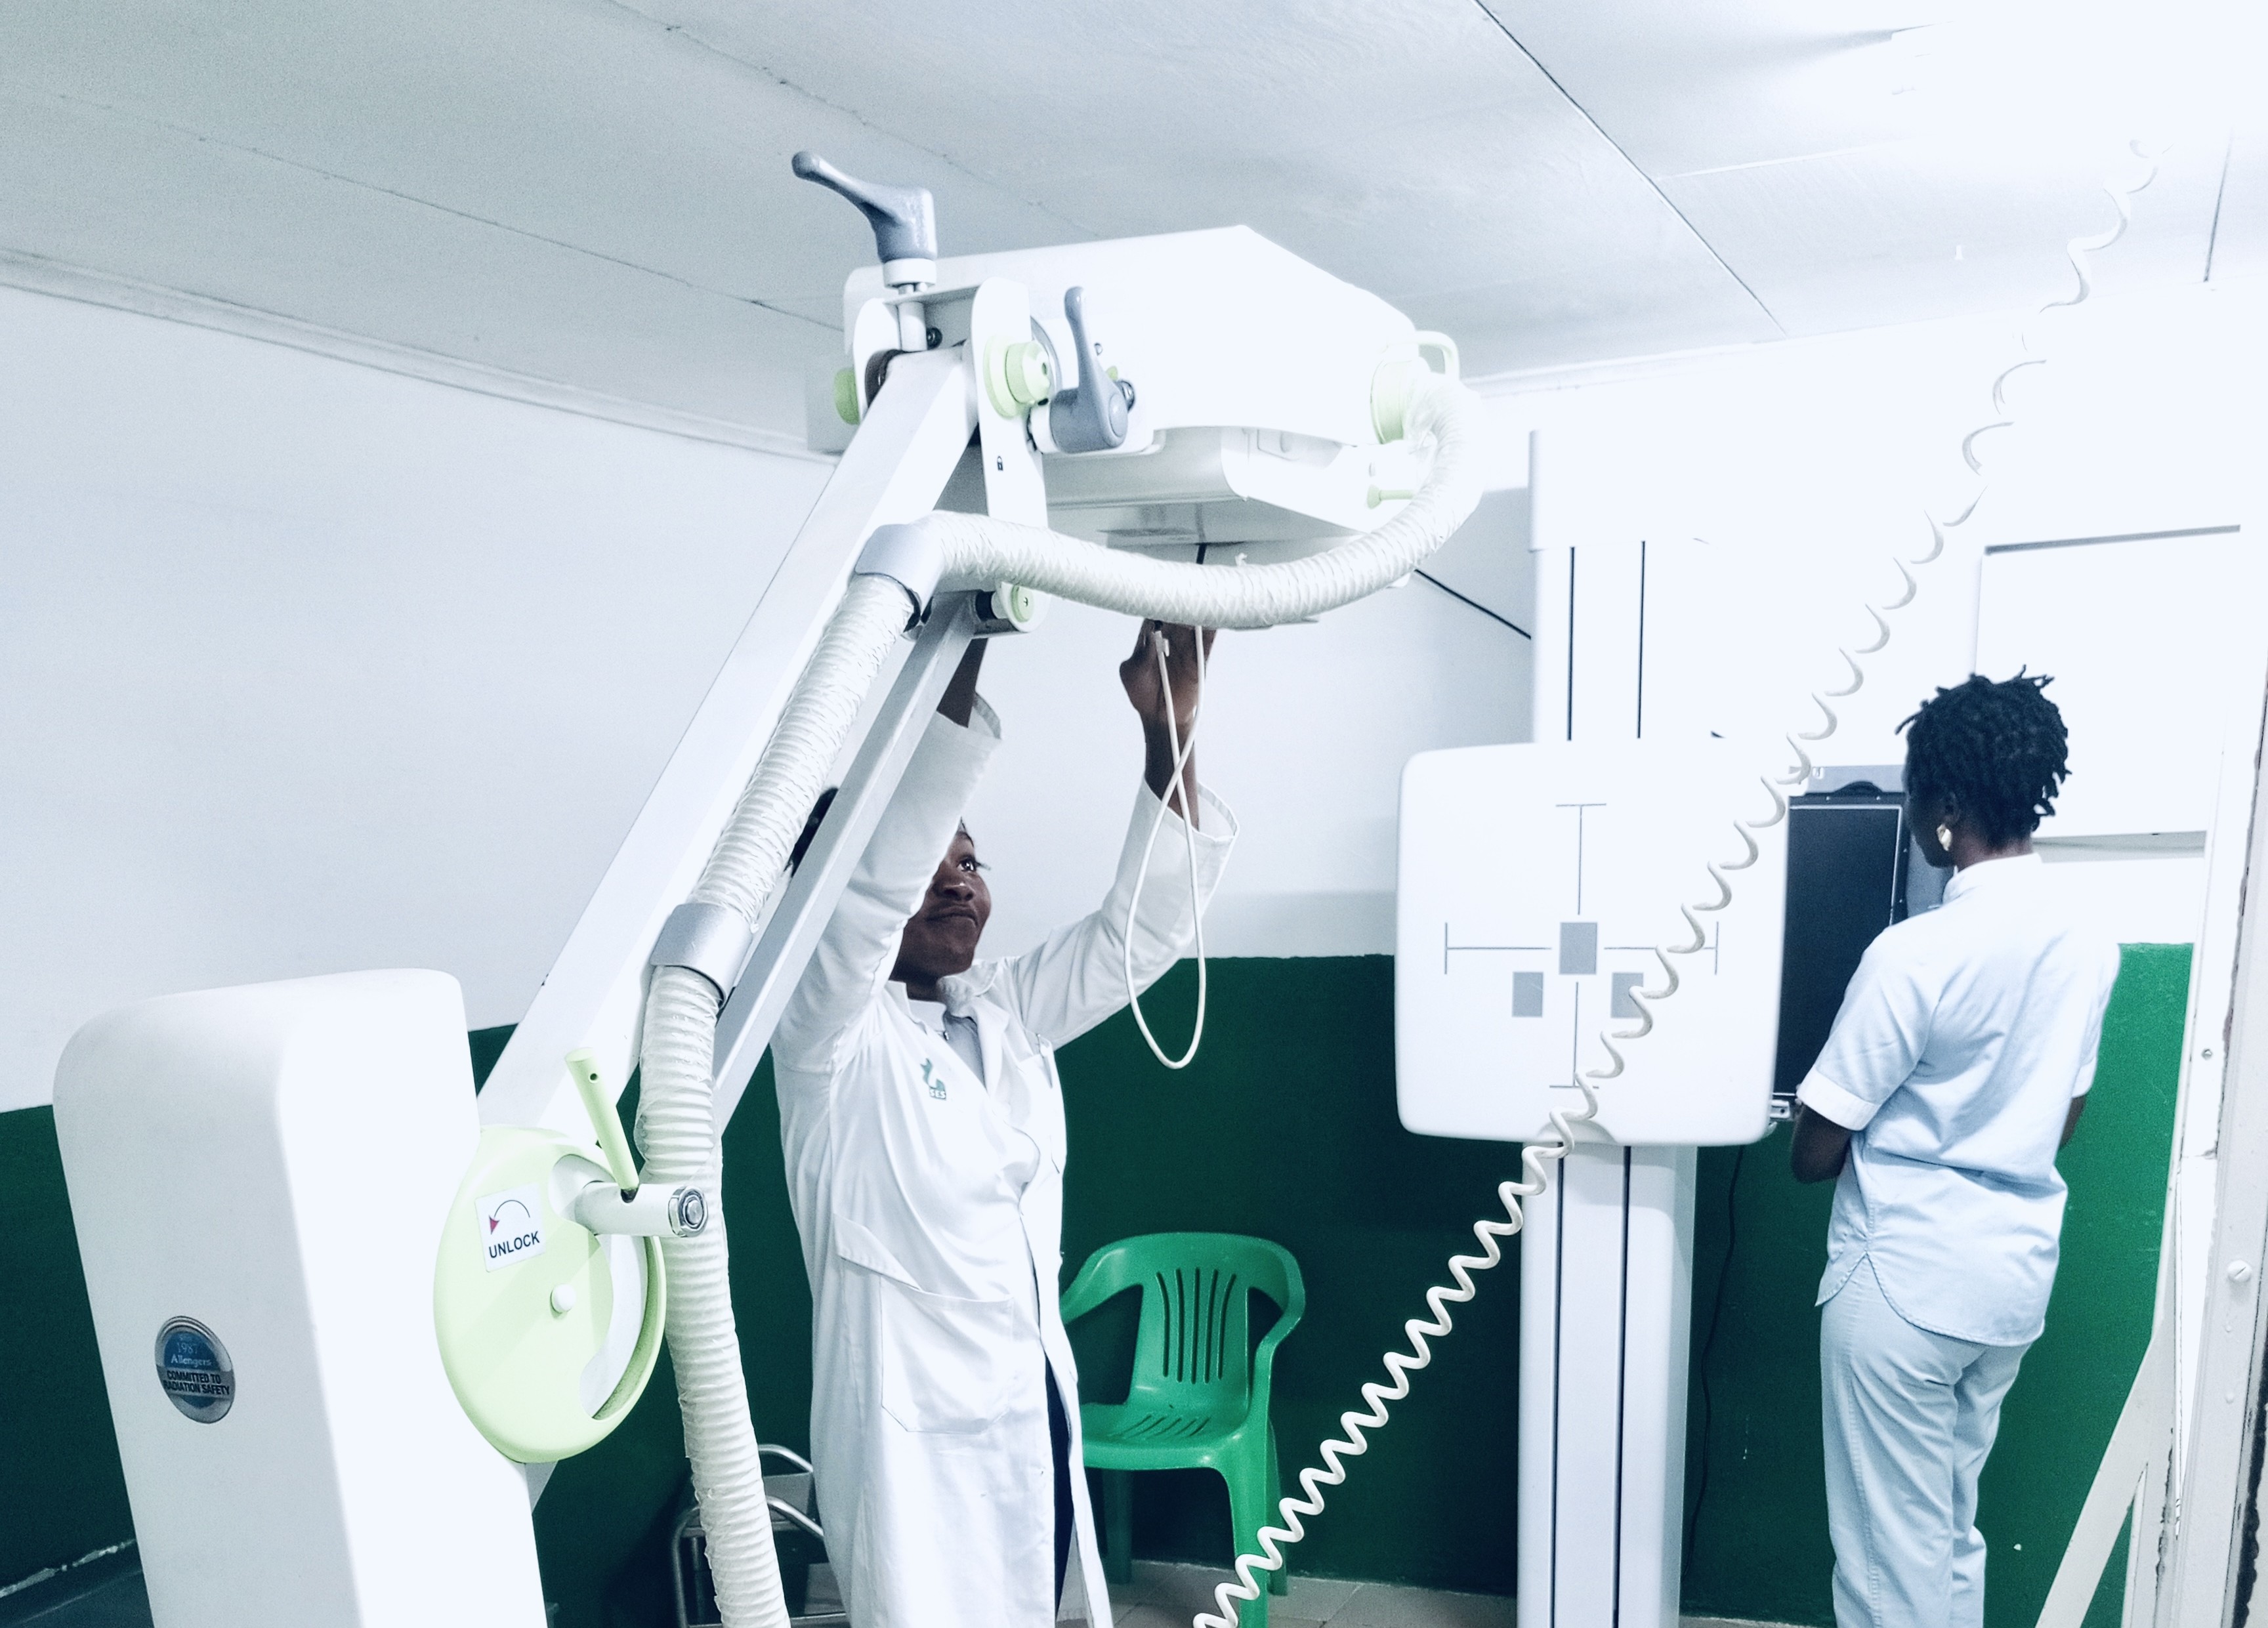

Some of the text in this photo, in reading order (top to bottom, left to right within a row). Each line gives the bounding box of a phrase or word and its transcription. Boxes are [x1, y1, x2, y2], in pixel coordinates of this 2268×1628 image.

[489, 1230, 540, 1259] UNLOCK
[171, 1354, 212, 1367] Allengers
[167, 1370, 221, 1384] COMMITTED TO
[202, 1383, 230, 1396] SAFETY
